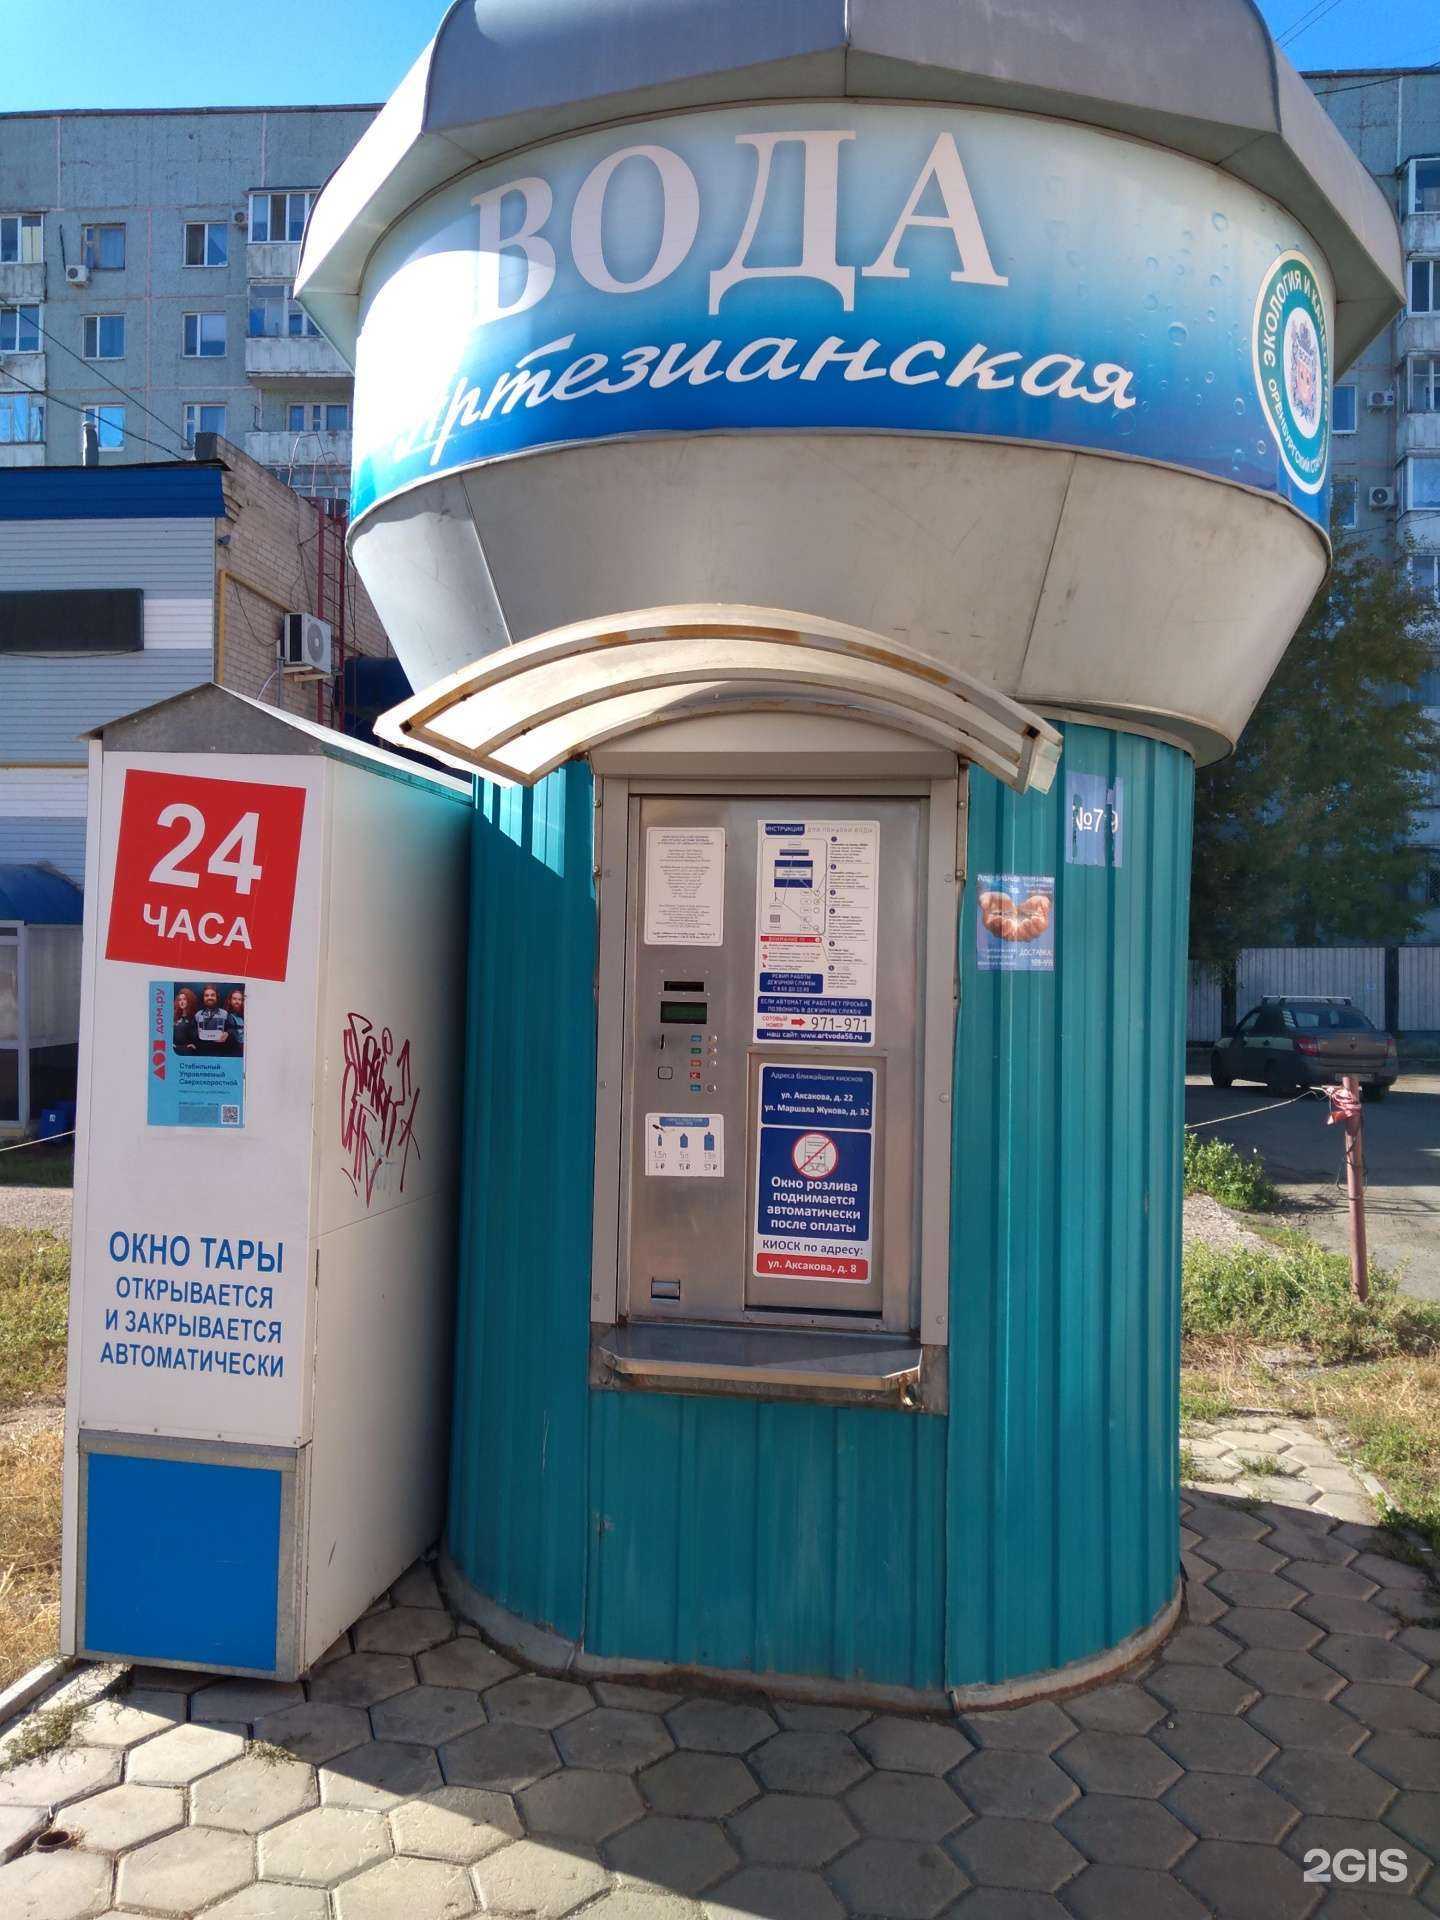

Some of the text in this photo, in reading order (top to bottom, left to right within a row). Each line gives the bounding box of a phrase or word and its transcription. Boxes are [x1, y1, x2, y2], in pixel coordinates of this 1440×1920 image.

[470, 129, 1009, 327] ВОДА
[1264, 270, 1302, 367] ЭКОЛОГИЯ
[148, 803, 263, 895] 24
[143, 903, 253, 950] ЧАСА
[812, 1016, 867, 1031] 971-971
[781, 1092, 792, 1100] ул.
[794, 1092, 832, 1102] Аксакова,
[843, 1094, 853, 1102] 22
[764, 1104, 775, 1112] ул.
[777, 1104, 815, 1113] Маршала
[817, 1106, 848, 1116] Жукова,
[771, 1176, 858, 1193] Окно розлива
[773, 1192, 856, 1206] поднимается
[767, 1205, 861, 1219] автоматически
[771, 1219, 856, 1233] после оплаты
[109, 1231, 284, 1273] ОКНО ТАРЫ
[762, 1240, 864, 1258] КИОСК по адресу:
[767, 1259, 857, 1274] ул. Аксакова, д. 8
[116, 1276, 273, 1309] ОТКРЫВАЕТСЯ
[105, 1309, 282, 1343] И ЗАКРЫВАЕТСЯ
[100, 1341, 284, 1378] АВТОМАТИЧЕСКИ
